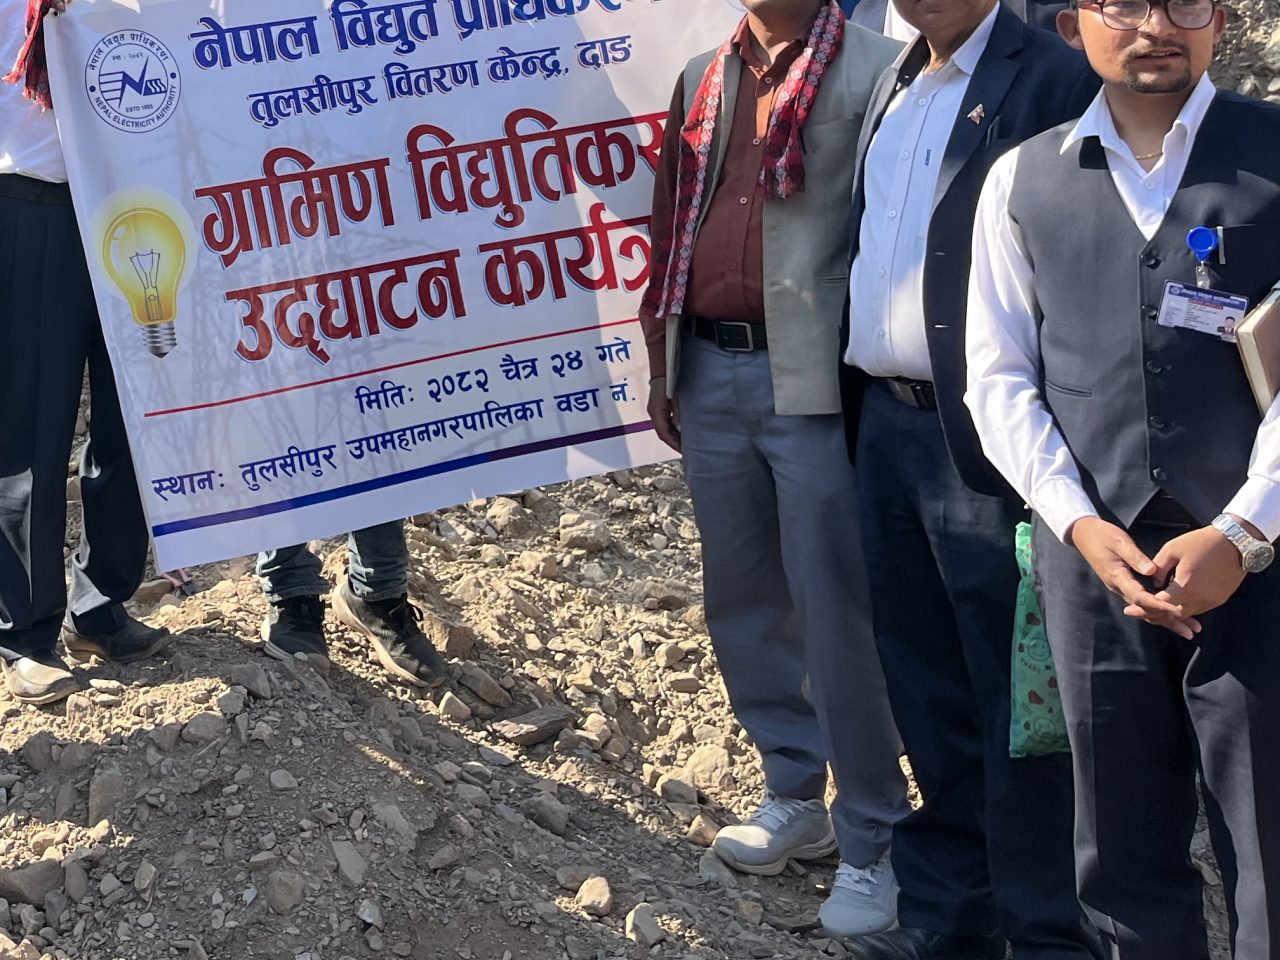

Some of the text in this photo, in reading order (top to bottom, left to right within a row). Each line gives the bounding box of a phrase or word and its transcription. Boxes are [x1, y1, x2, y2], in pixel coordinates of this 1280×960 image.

[189, 16, 320, 69] नेपाल
[248, 74, 377, 128] तुलसीपुर
[385, 59, 480, 102] वितरण
[575, 35, 632, 70] दाङ
[95, 85, 176, 128] NEPAL ELECTRICITY AUTHORITY
[195, 108, 668, 270] ग्रामिण विद्युतिकर
[427, 368, 490, 403] २०८२
[499, 354, 538, 382] चैत्र
[551, 351, 583, 377] २४
[596, 337, 632, 364] गते
[238, 445, 336, 491] तुलसीपुर
[346, 398, 544, 461] उपमहानगरपालिका
[555, 387, 599, 414] वडा
